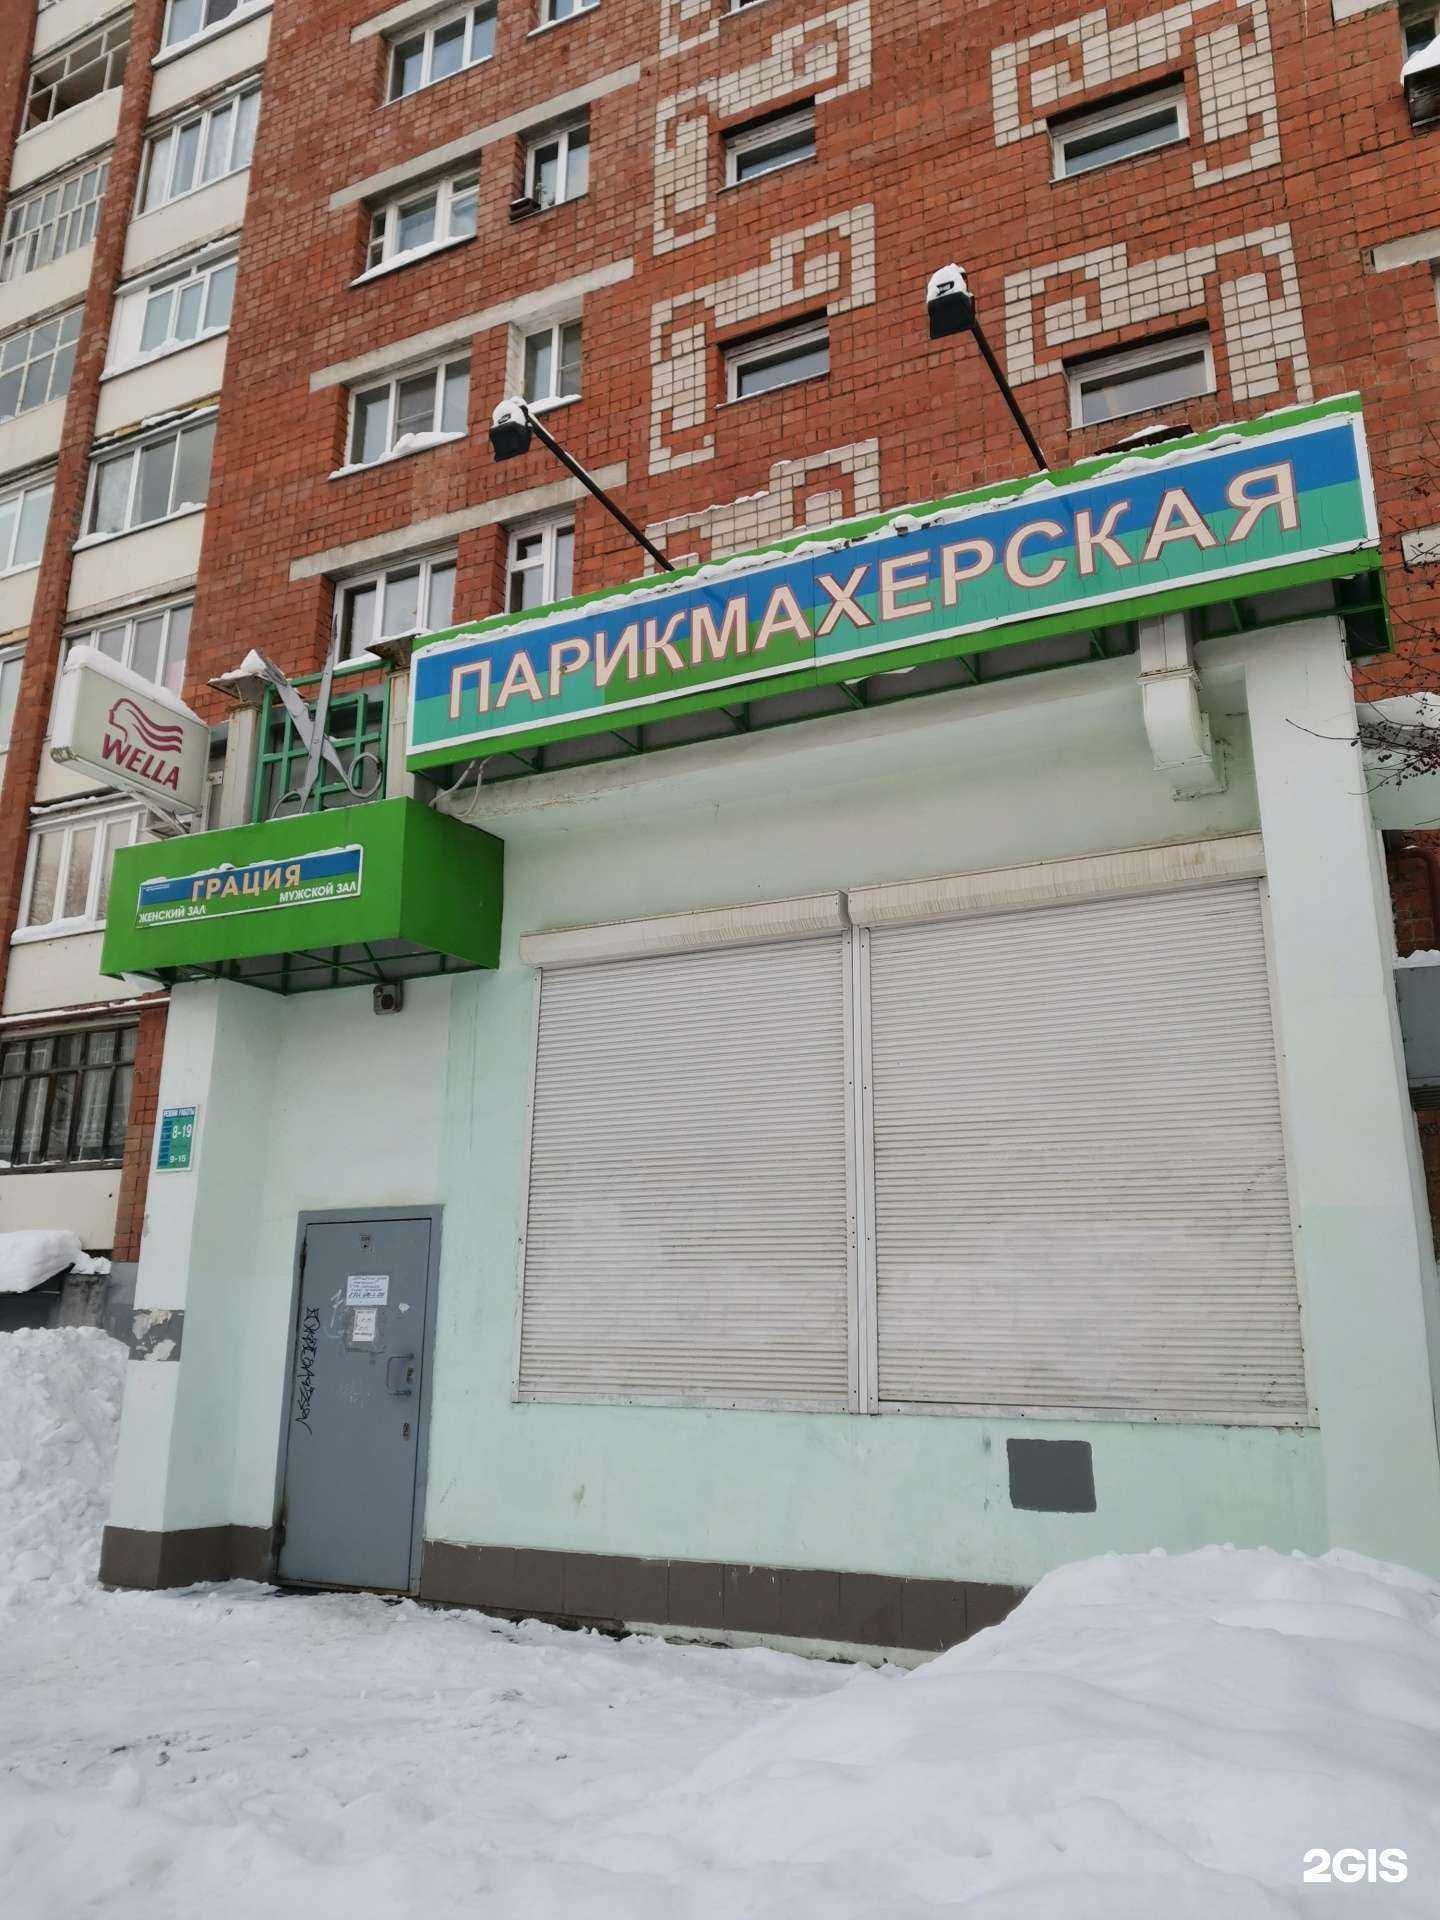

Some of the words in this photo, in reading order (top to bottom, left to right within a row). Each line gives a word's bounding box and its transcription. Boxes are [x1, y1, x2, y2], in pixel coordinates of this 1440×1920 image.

[447, 460, 1300, 720] ПАРИКМАХЕРСКАЯ
[101, 733, 180, 791] WELLA
[191, 863, 301, 903] ГРАЦИЯ
[279, 883, 333, 904] МУЖСКОЙ
[335, 881, 358, 895] ЗАЛ
[138, 905, 185, 924] ЖЕНСКИЙ
[186, 903, 207, 917] ЗАЛ
[172, 1124, 192, 1139] 8-19
